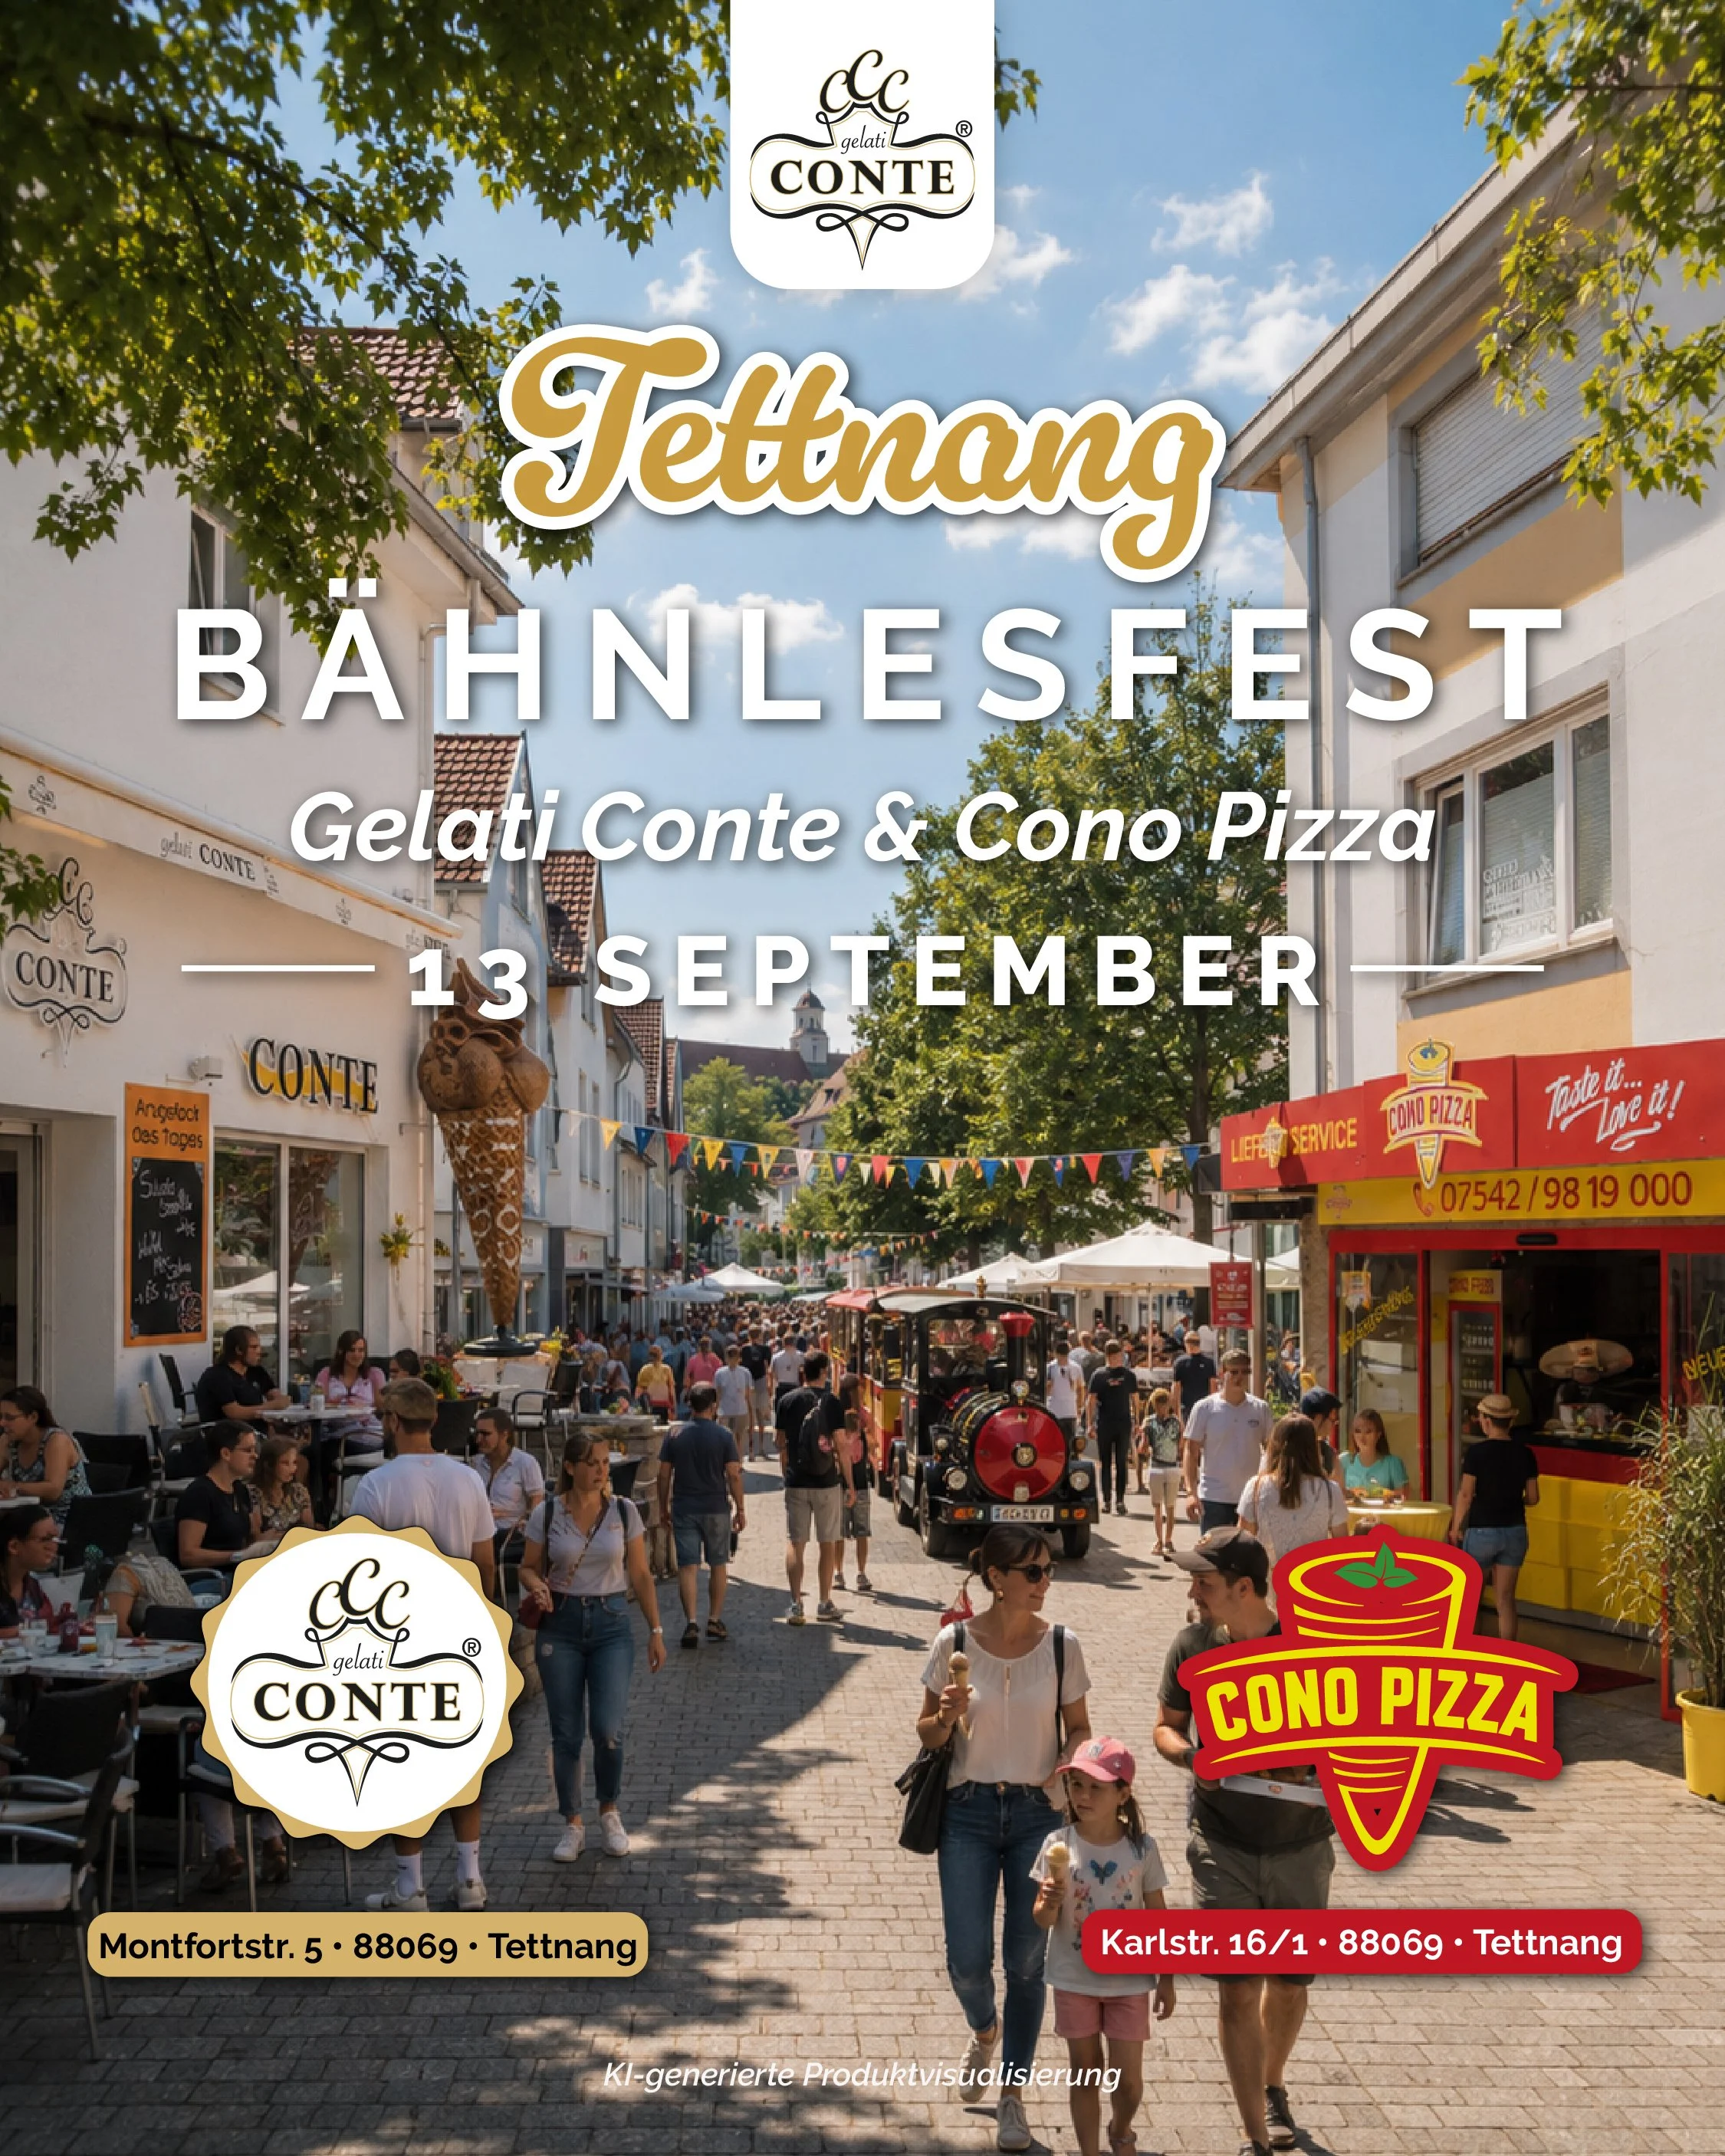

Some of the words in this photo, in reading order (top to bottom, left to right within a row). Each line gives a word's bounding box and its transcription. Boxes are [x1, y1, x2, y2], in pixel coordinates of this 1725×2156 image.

[199, 843, 256, 882] CONTE
[16, 951, 114, 1003] CONTE
[249, 1037, 378, 1114] CONTE
[1546, 1064, 1600, 1131] Taste
[1290, 1117, 1358, 1155] SERVICE
[1389, 1096, 1424, 1136] CONO
[1430, 1094, 1473, 1130] PIZZA
[1595, 1093, 1643, 1143] Love
[1628, 1171, 1693, 1207] 000
